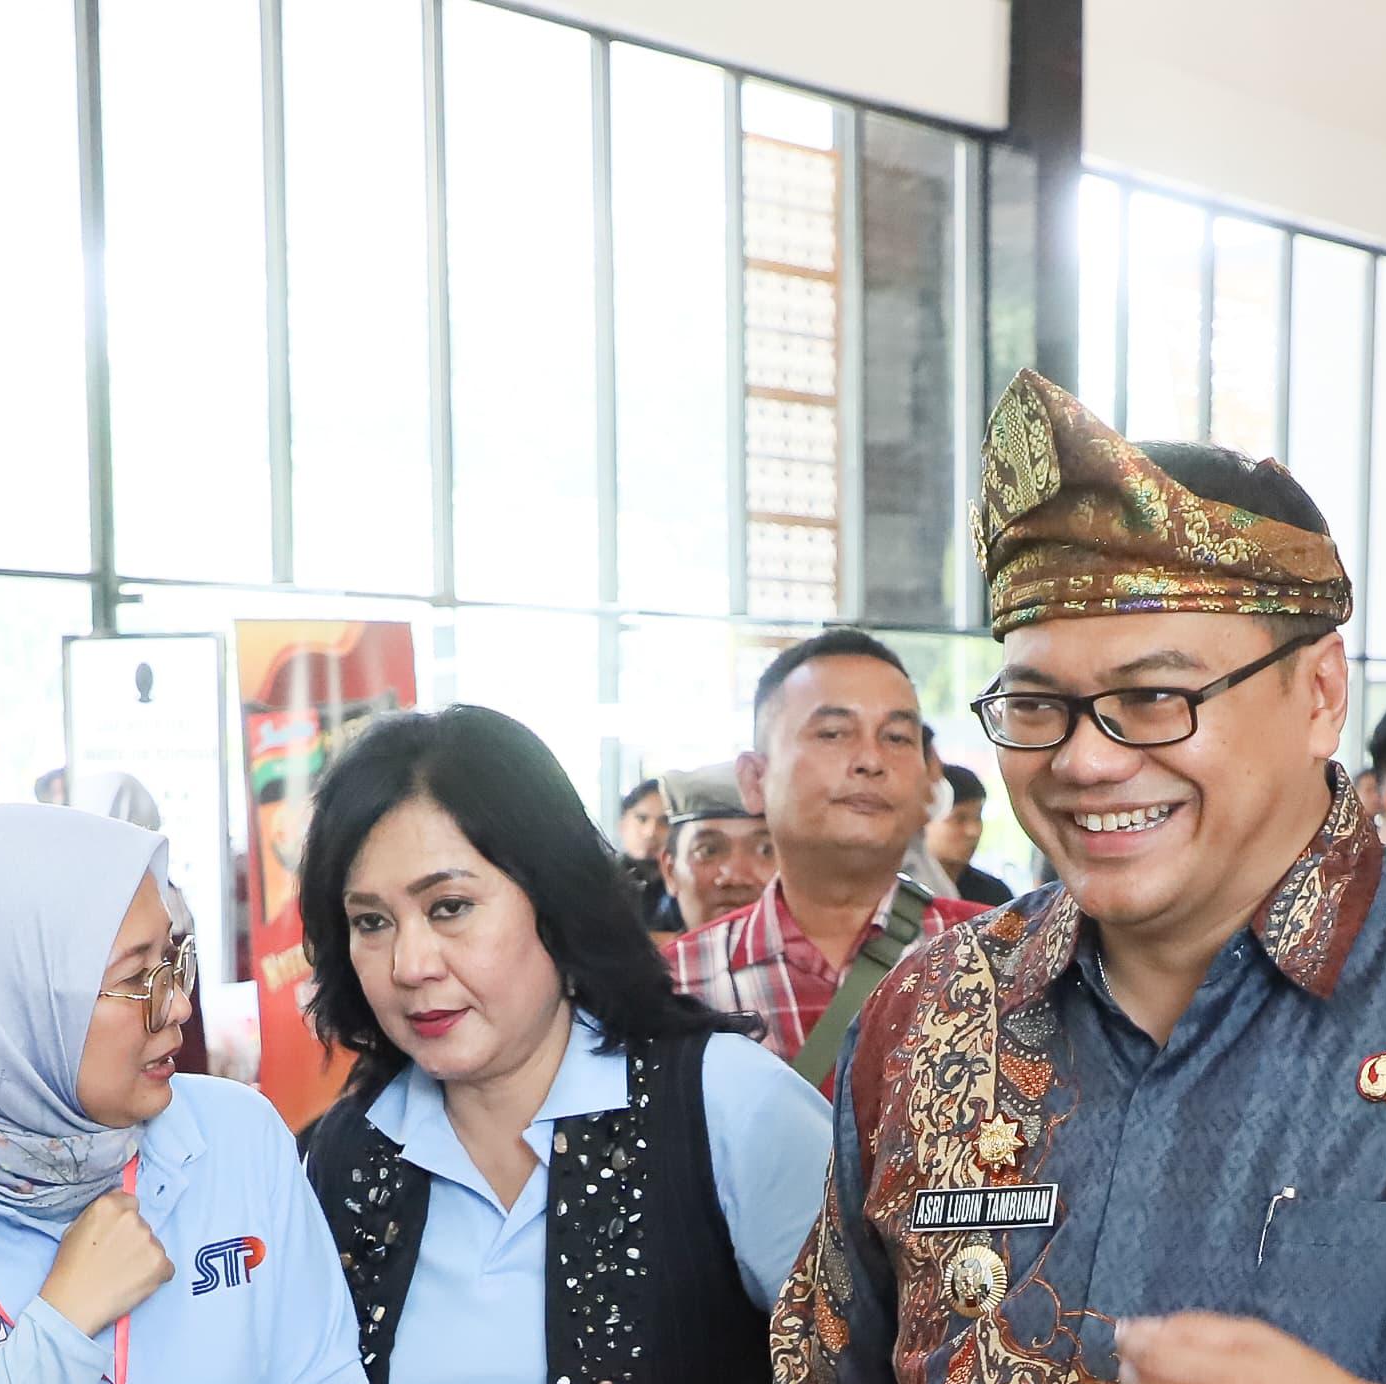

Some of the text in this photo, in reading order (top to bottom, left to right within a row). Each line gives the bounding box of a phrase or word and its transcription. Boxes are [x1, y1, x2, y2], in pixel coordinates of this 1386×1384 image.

[915, 1190, 1051, 1225] ASRI LUDIN TAMBUNAN
[191, 1236, 268, 1296] STP
